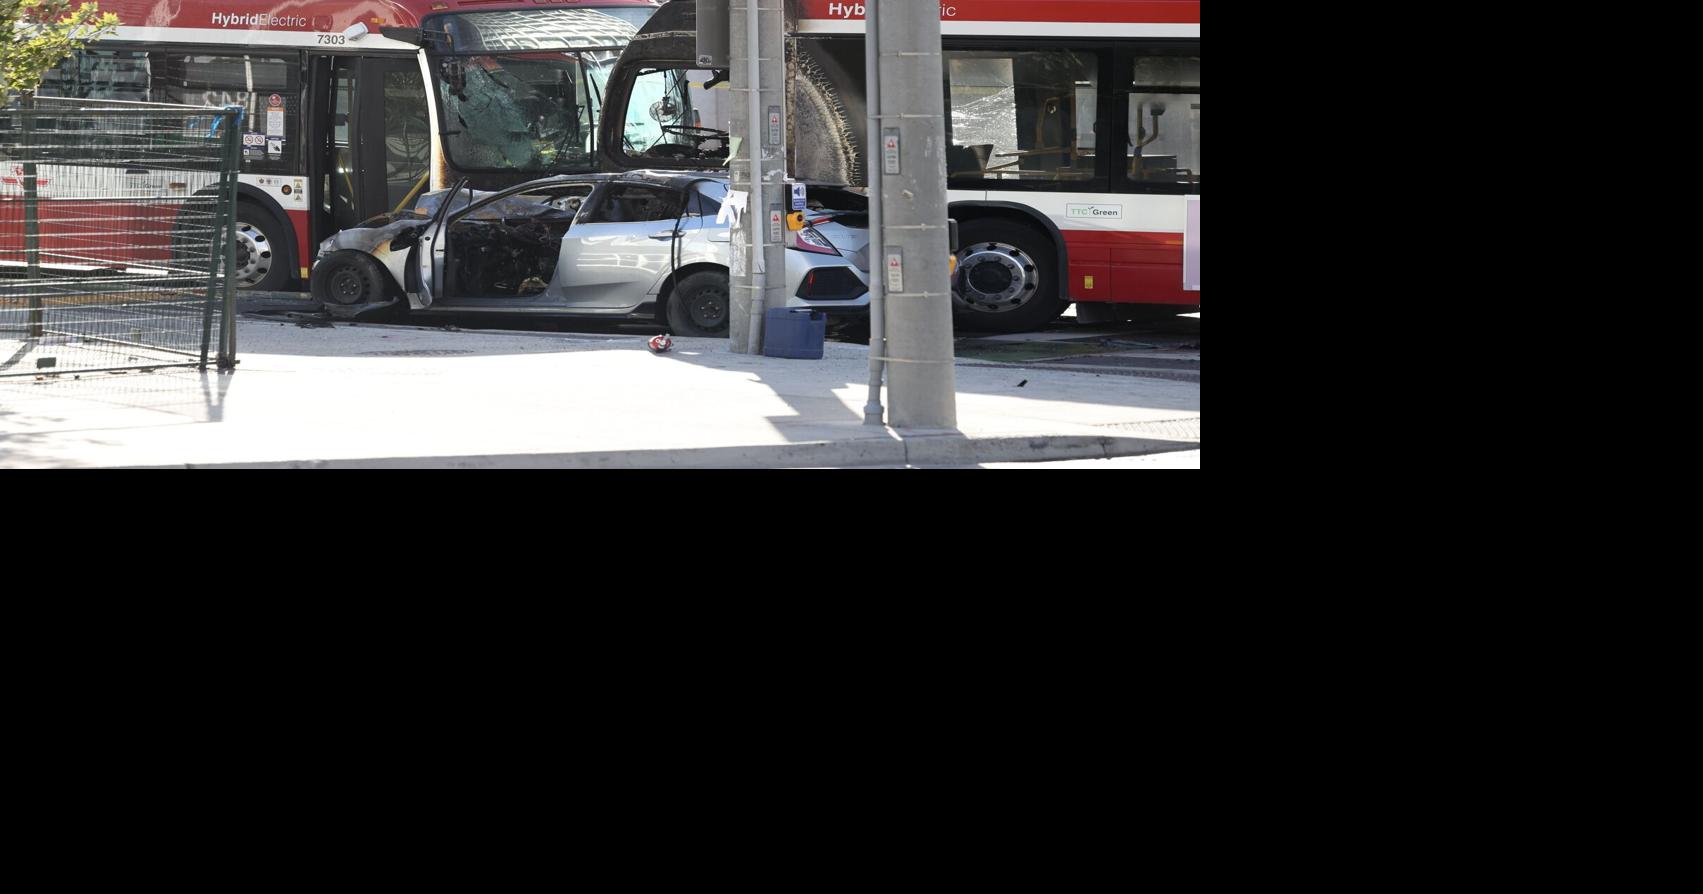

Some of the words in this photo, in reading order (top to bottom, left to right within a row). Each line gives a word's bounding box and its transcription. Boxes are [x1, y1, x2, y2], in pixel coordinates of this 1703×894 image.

[211, 12, 307, 27] HybridElectric
[316, 34, 345, 45] 7303
[1071, 208, 1088, 216] TTC
[1092, 208, 1118, 216] Green
